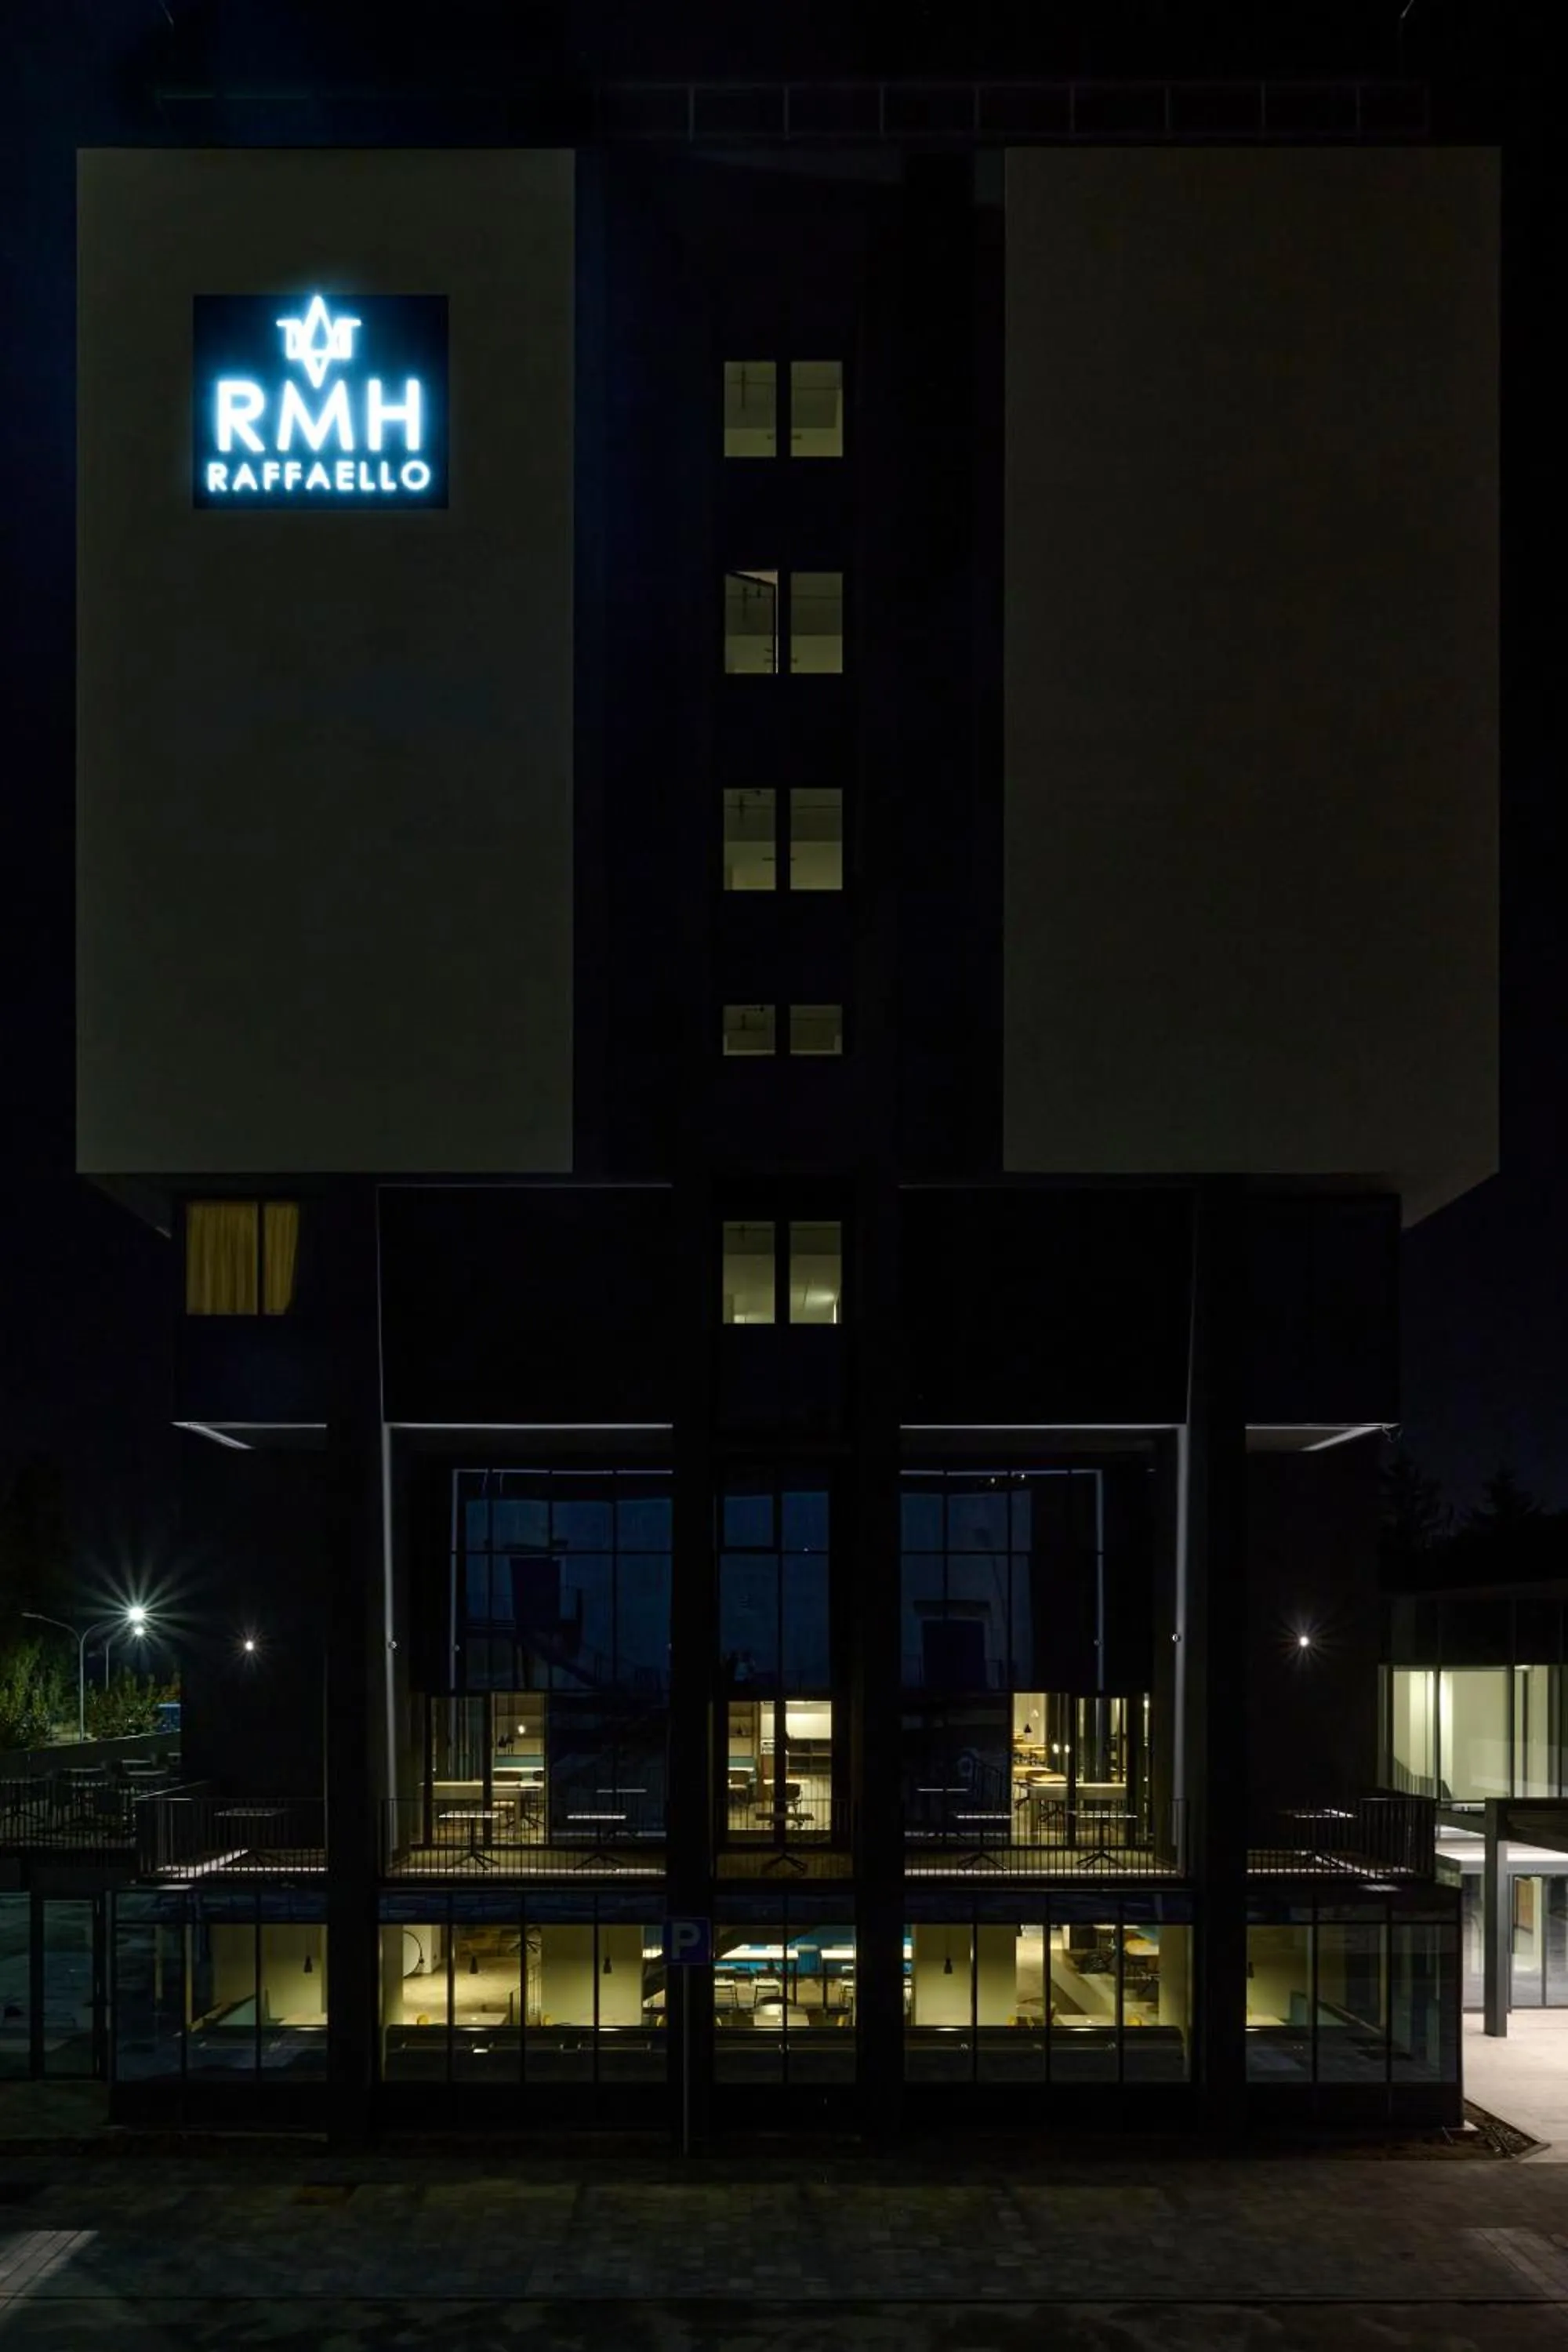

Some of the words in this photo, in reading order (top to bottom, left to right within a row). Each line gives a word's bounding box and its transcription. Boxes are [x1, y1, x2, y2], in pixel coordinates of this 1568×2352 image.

[216, 378, 421, 452] RMH
[206, 460, 430, 492] RAFFAELLO
[671, 1922, 702, 1961] P
